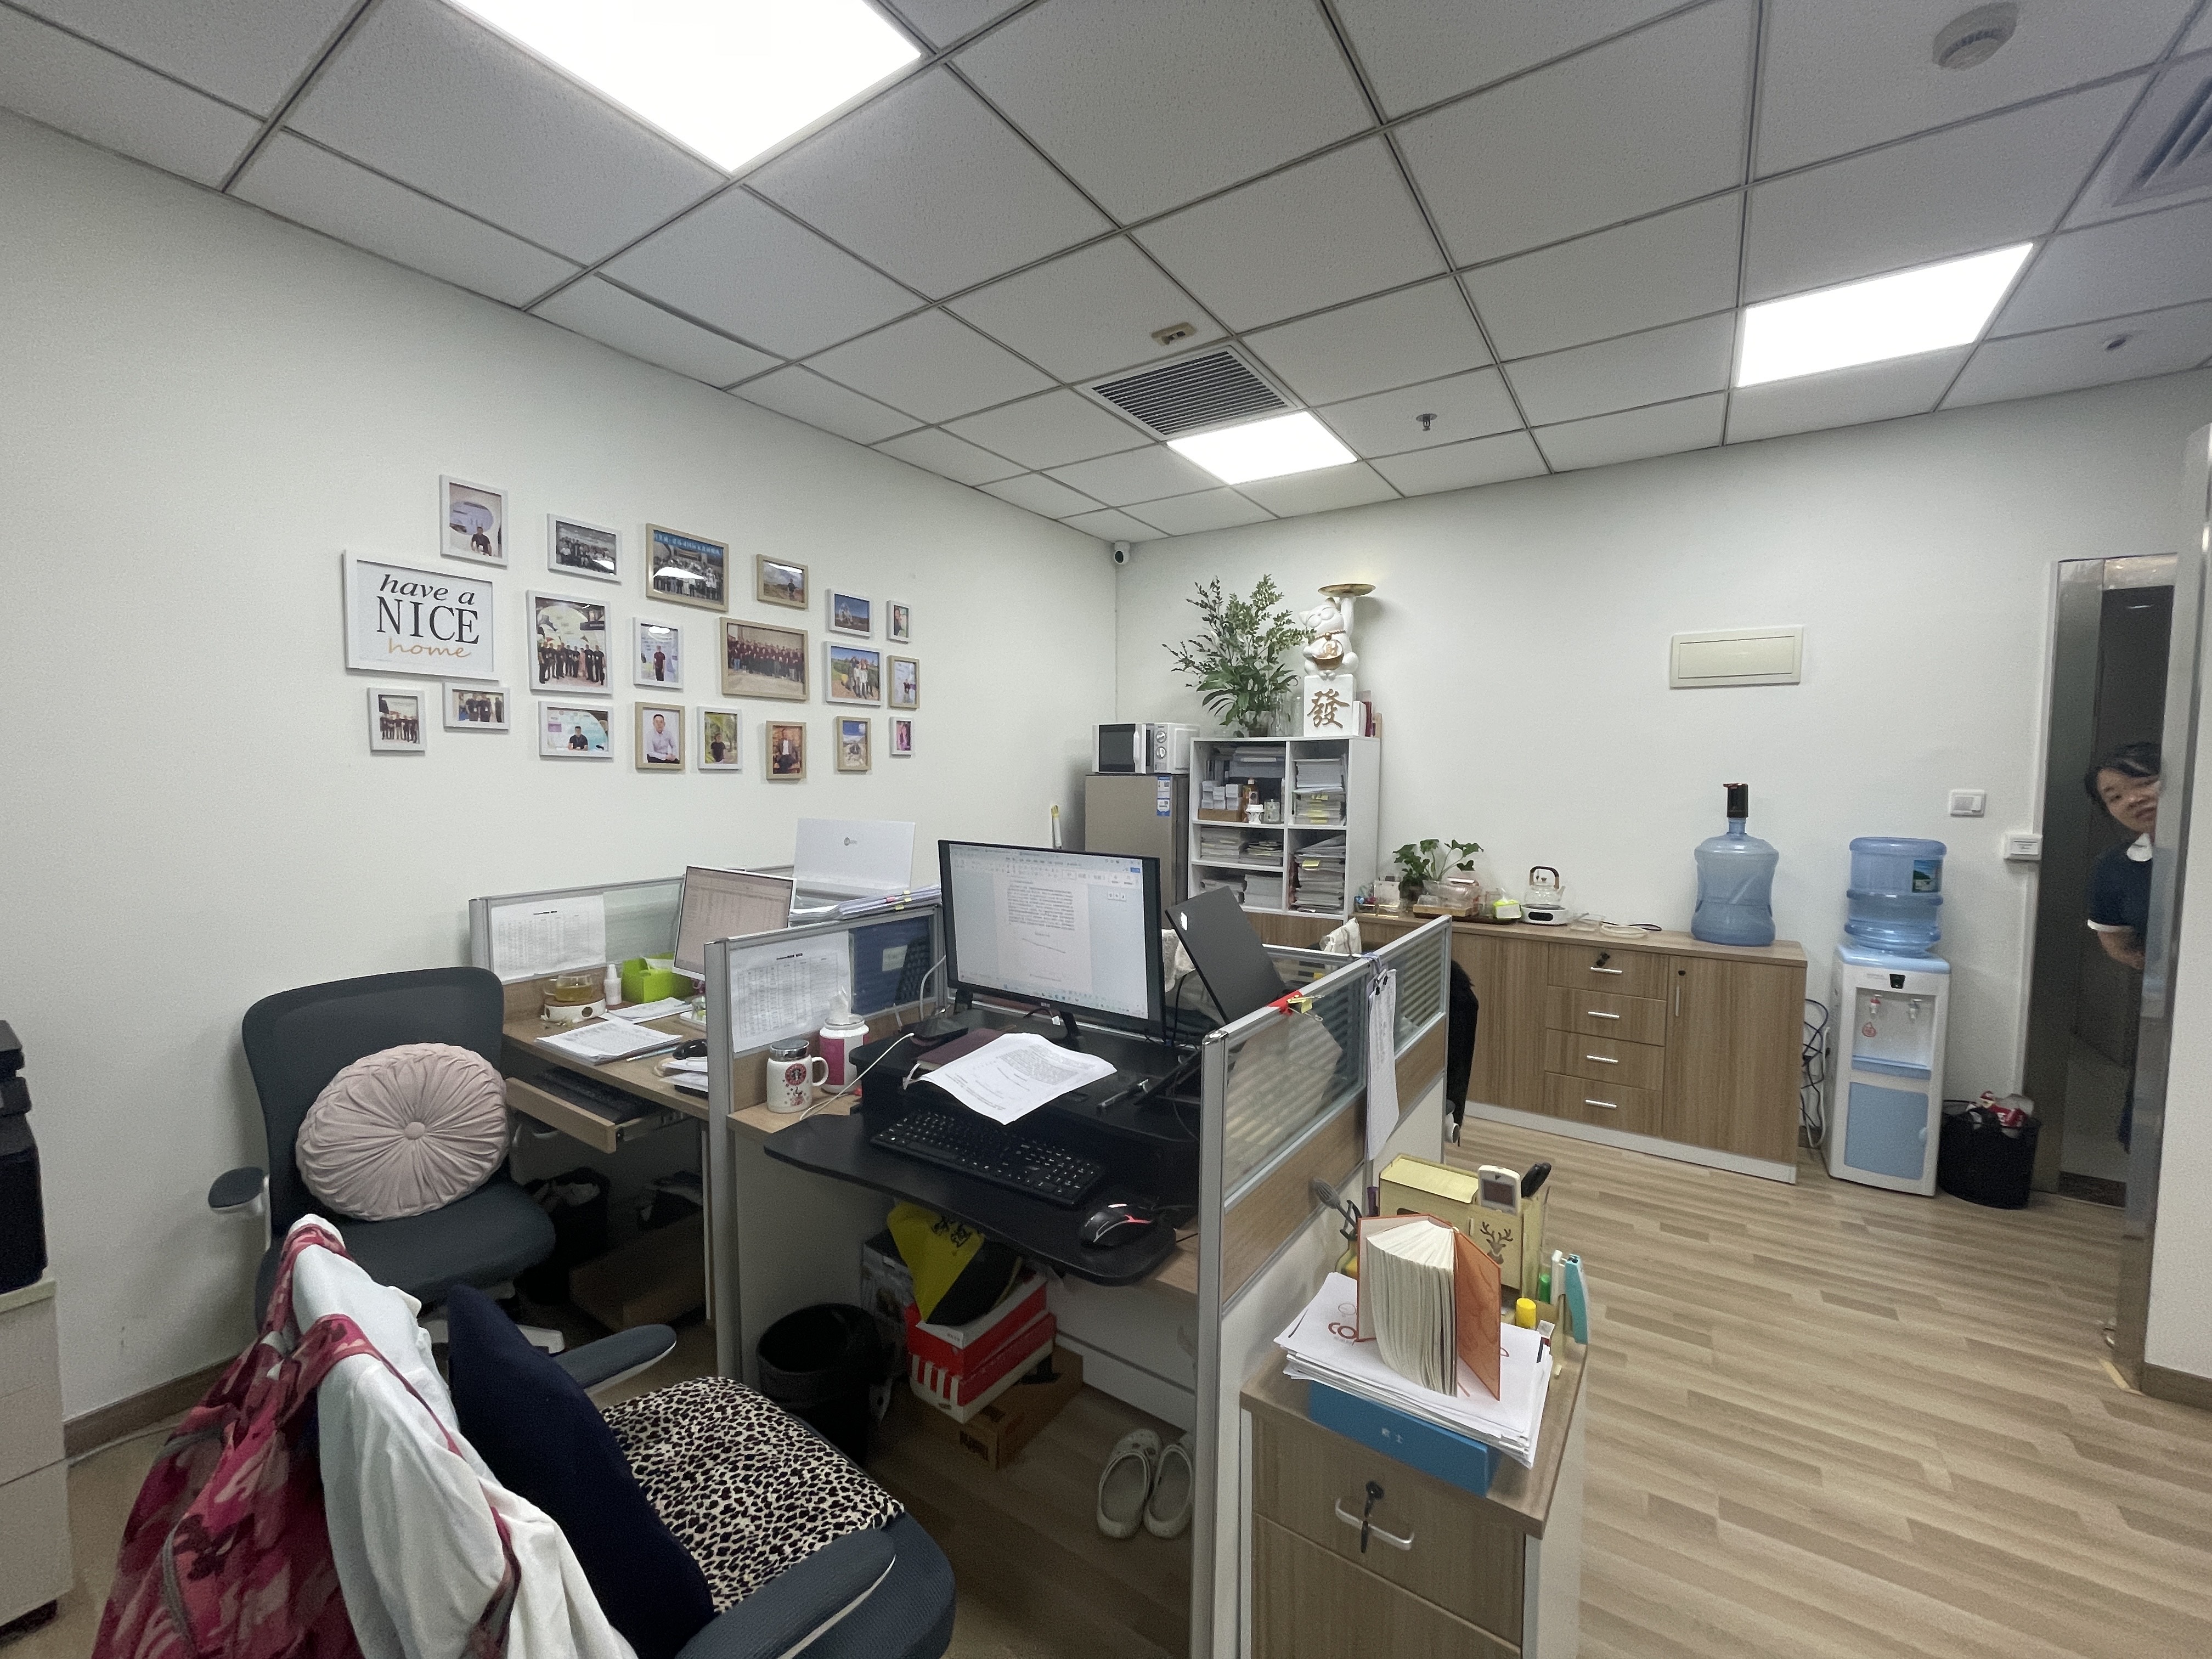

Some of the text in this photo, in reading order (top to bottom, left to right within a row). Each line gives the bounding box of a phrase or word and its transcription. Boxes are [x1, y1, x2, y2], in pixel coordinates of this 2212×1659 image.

[380, 574, 475, 605] have a
[376, 595, 479, 644] NICE
[388, 637, 471, 658] home
[1307, 688, 1350, 729] 發
